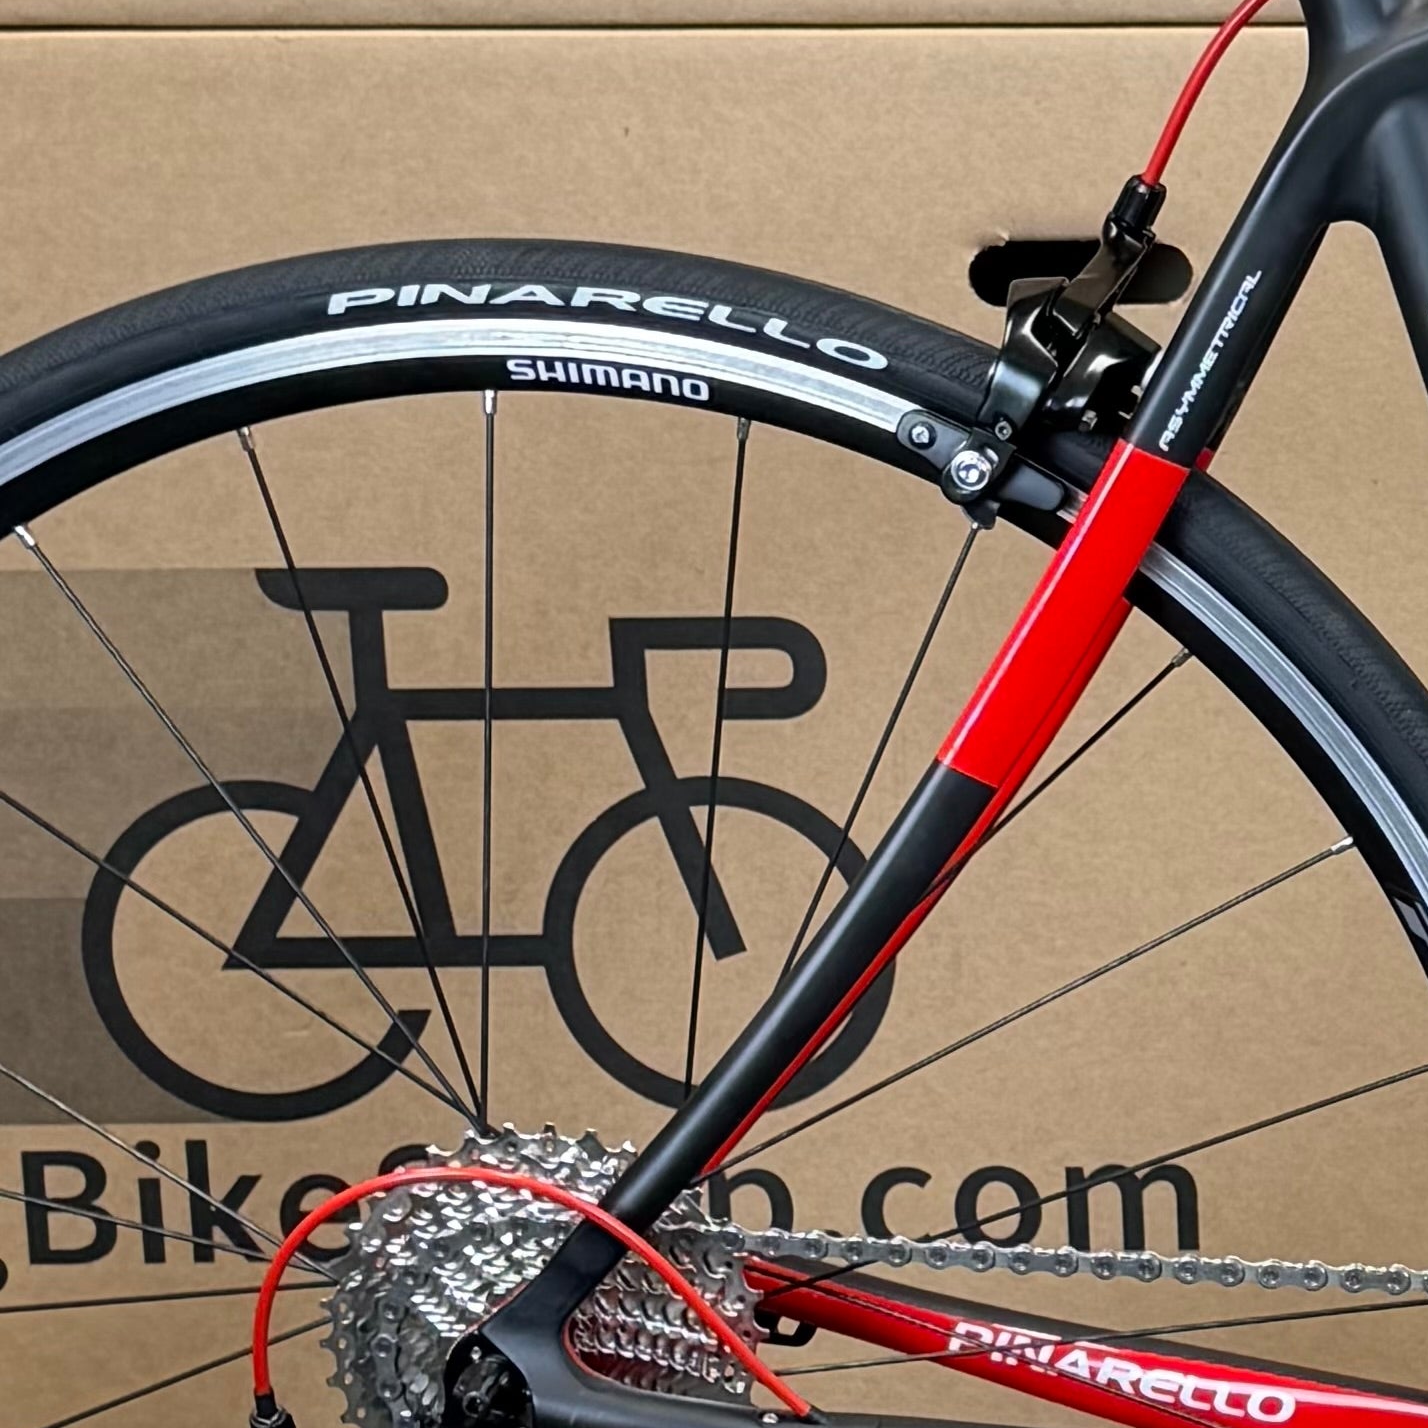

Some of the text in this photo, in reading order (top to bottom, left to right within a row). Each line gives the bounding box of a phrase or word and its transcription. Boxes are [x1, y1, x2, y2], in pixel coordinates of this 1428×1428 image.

[326, 283, 889, 371] PINARELLO
[1158, 269, 1263, 452] ASYMMETRICAL
[506, 357, 711, 402] SHIMANO
[948, 1321, 1297, 1424] PINARELLO
